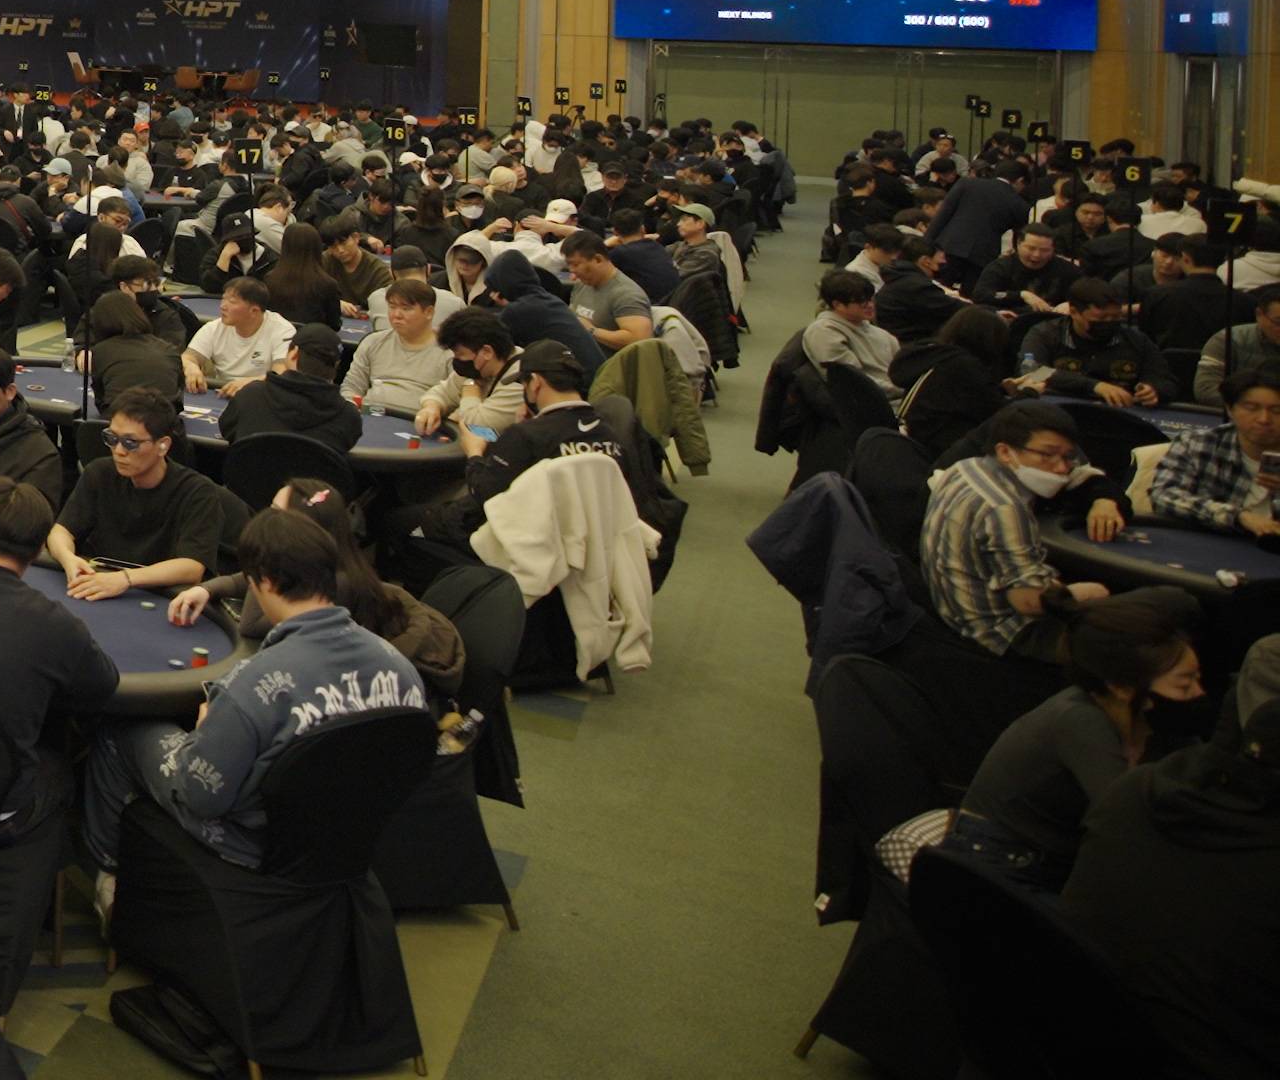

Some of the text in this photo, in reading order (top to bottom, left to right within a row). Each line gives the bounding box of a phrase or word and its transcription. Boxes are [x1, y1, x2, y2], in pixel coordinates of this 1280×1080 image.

[183, 0, 241, 18] HPT
[144, 83, 157, 91] 24
[591, 87, 602, 95] 12
[36, 91, 49, 100] 25
[556, 91, 569, 100] 13
[518, 102, 530, 111] 14
[980, 104, 988, 114] 2
[459, 114, 475, 125] 15
[1007, 114, 1017, 124] 3
[386, 126, 404, 140] 16
[1034, 127, 1043, 137] 4
[237, 149, 260, 165] 17
[1071, 147, 1083, 160] 5
[1125, 166, 1140, 181] 6
[1224, 213, 1243, 233] 7
